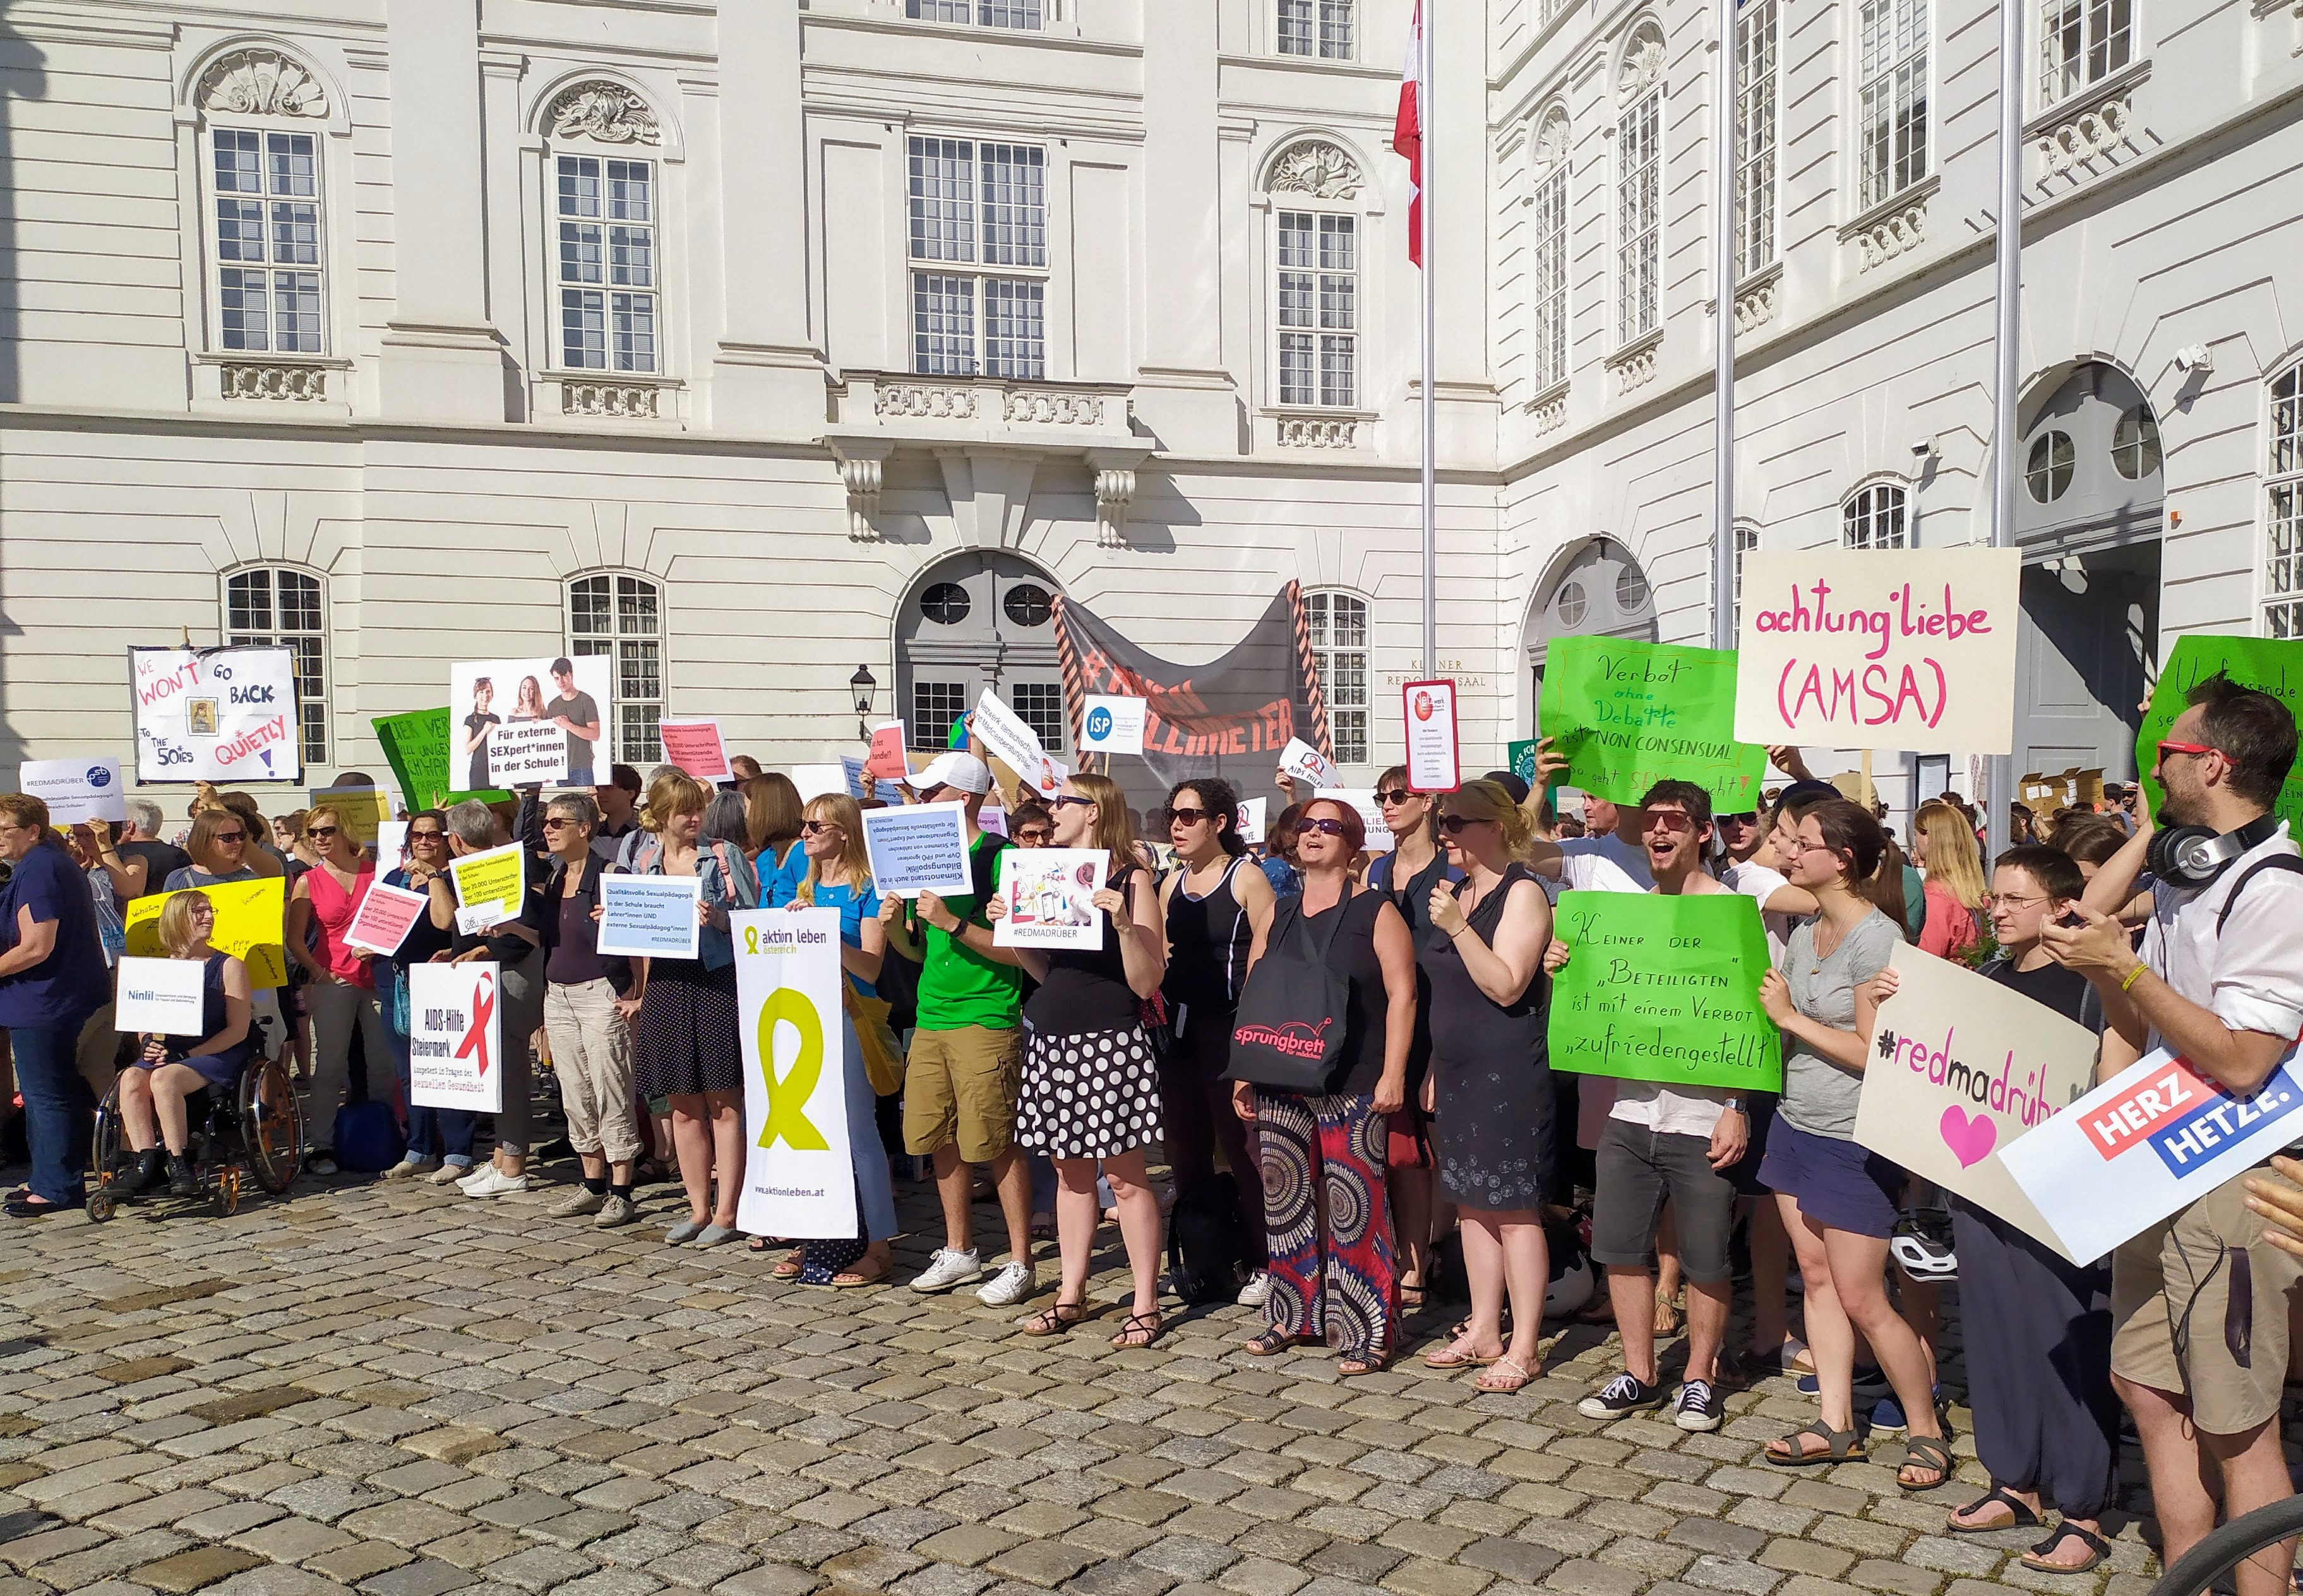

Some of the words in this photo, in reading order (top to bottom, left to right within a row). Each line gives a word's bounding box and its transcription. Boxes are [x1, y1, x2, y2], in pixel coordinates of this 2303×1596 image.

[138, 660, 153, 676] WE
[214, 664, 232, 680] GO
[1411, 660, 1462, 669] KLNER
[1597, 655, 1692, 684] Verbot
[230, 684, 275, 704] BACK
[1614, 687, 1654, 701] ohne
[1778, 657, 1946, 729] (AMSA)
[979, 700, 1001, 725] Netzwerk
[1594, 700, 1677, 729] Debatte
[498, 730, 514, 741] Für
[518, 727, 556, 738] externe
[151, 737, 168, 747] THE
[1562, 724, 1592, 744] ist
[1596, 730, 1630, 749] NON
[1635, 735, 1732, 760] CONSENSUAL
[1523, 744, 1534, 756] FOR
[491, 763, 500, 772] in
[505, 761, 520, 771] der
[525, 757, 559, 769] Schule
[27, 778, 83, 786] #REDMADRÜBER
[1592, 768, 1619, 787] geht
[911, 821, 945, 830] qualitätsvolle
[906, 862, 962, 874] Bildungspolitik!
[471, 880, 488, 889] 20.000
[488, 872, 518, 885] Unterschriften
[911, 872, 962, 883] Klimanotstand
[483, 883, 515, 895] unterstützende
[647, 890, 693, 899] Sexualpädagogik
[762, 929, 792, 944] aktion
[797, 929, 827, 943] leben
[1014, 927, 1077, 938] #REDMADRÜBER
[128, 990, 153, 1001] Ninlil
[1572, 992, 1591, 1011] ist
[1599, 992, 1628, 1013] mit
[1634, 999, 1682, 1017] einem
[412, 1037, 450, 1057] Steiermark
[1235, 1029, 1325, 1053] sprungbrett
[1296, 1051, 1321, 1060] mädchen
[439, 1066, 445, 1075] in
[448, 1080, 484, 1092] Gesundheit
[2093, 1071, 2193, 1146] HERZ
[2163, 1090, 2290, 1165] HETZE.
